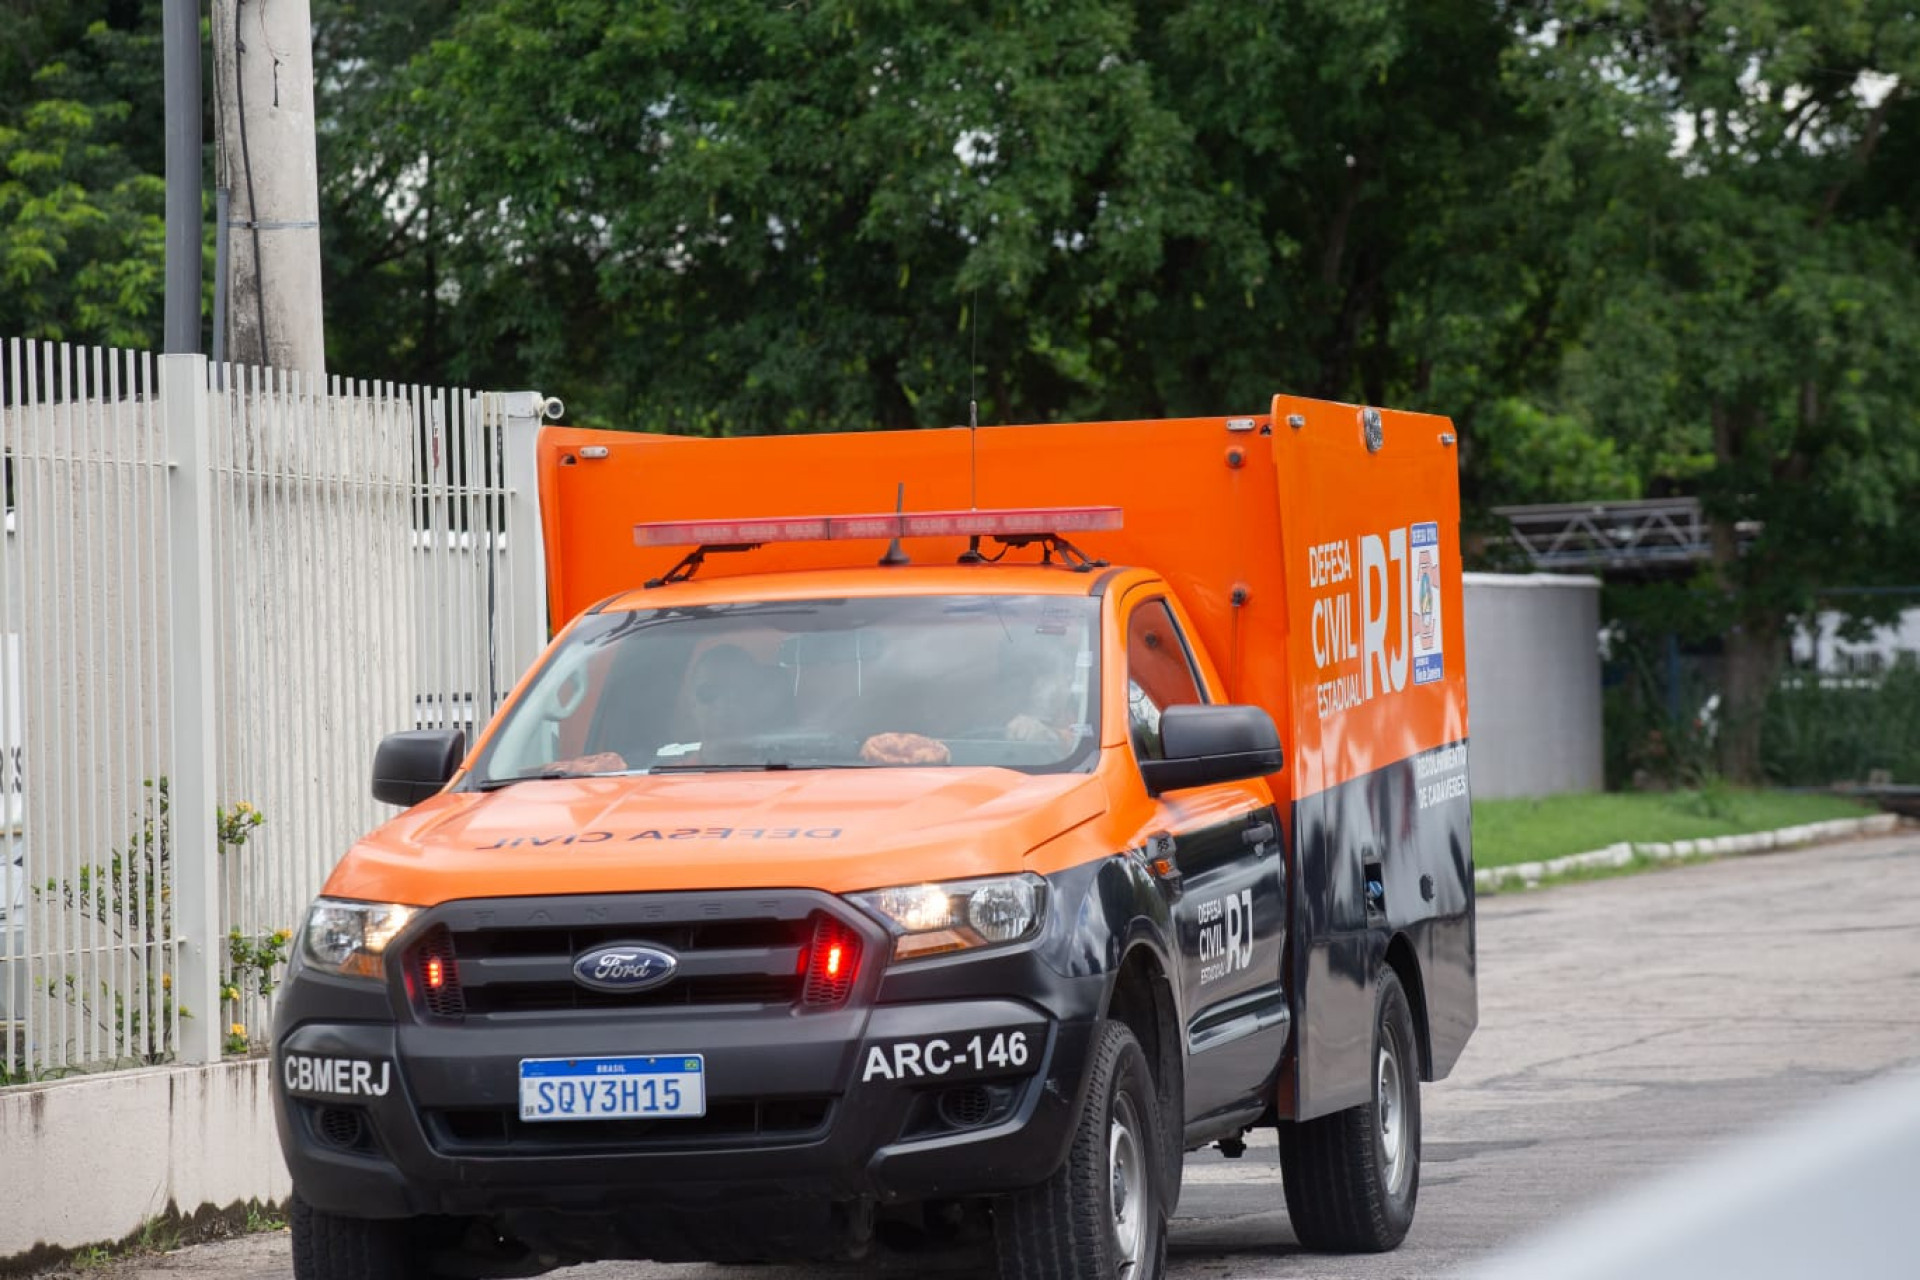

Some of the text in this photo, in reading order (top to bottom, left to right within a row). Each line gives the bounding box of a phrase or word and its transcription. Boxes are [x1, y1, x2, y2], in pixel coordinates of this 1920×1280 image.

[1308, 539, 1352, 588] DEFESA
[1312, 592, 1357, 669] CIVIL
[1361, 528, 1408, 699] RJ
[1318, 673, 1362, 719] ESTADUAL
[1200, 923, 1225, 963] CIVIL
[1226, 888, 1253, 975] RJ
[594, 954, 651, 979] Ford
[284, 1055, 390, 1097] CBMERJ
[862, 1031, 1028, 1082] ARC-146
[538, 1078, 680, 1114] SQY3H15
